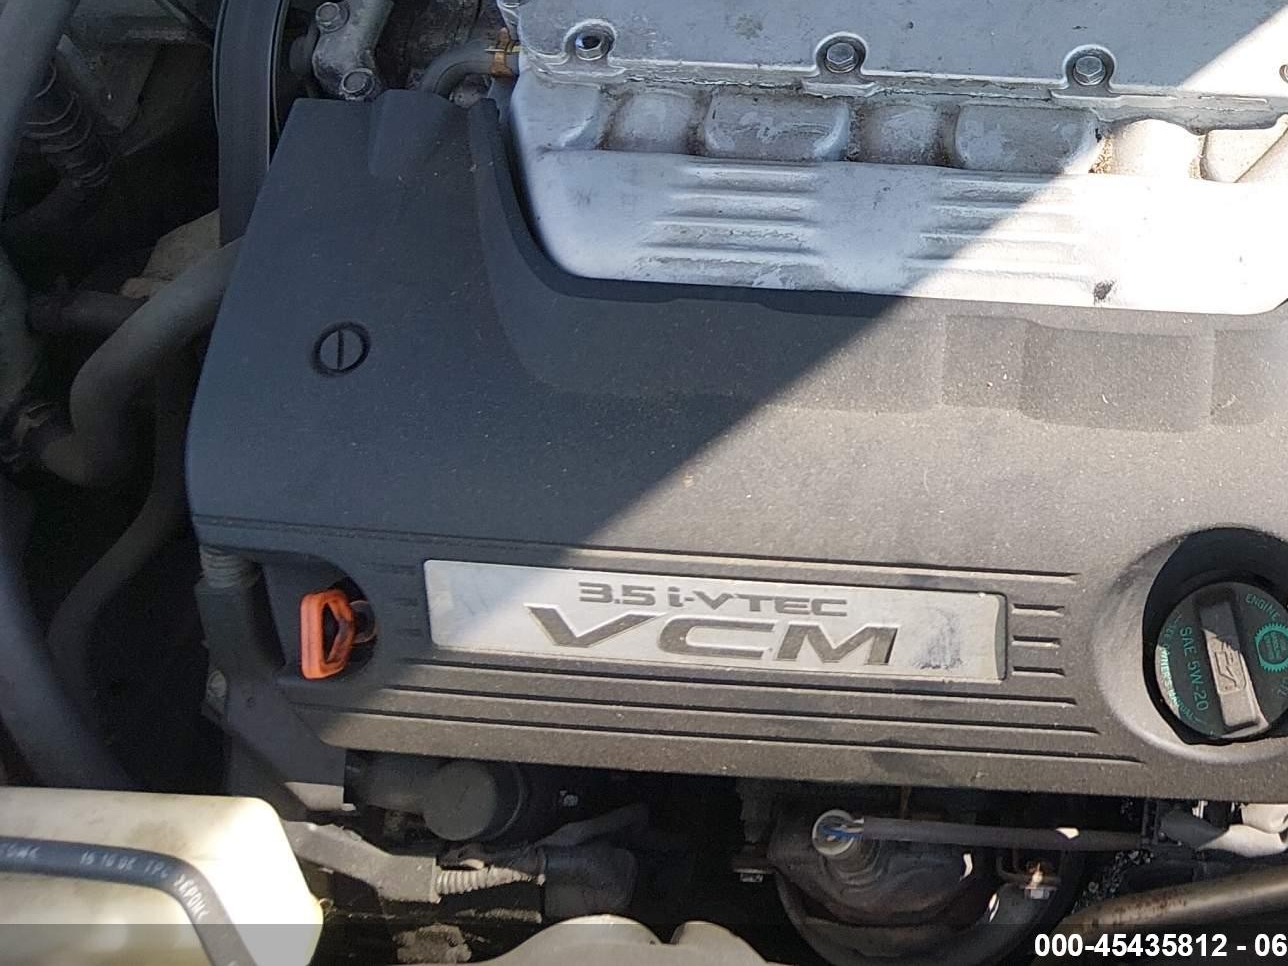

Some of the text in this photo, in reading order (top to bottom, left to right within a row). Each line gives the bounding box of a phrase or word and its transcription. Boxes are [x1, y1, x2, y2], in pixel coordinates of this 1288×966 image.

[578, 581, 848, 618] 3.5 i-VTEC
[1245, 592, 1282, 622] ENGINE
[523, 603, 901, 666] VCM
[1179, 626, 1209, 712] SAE 5W-20
